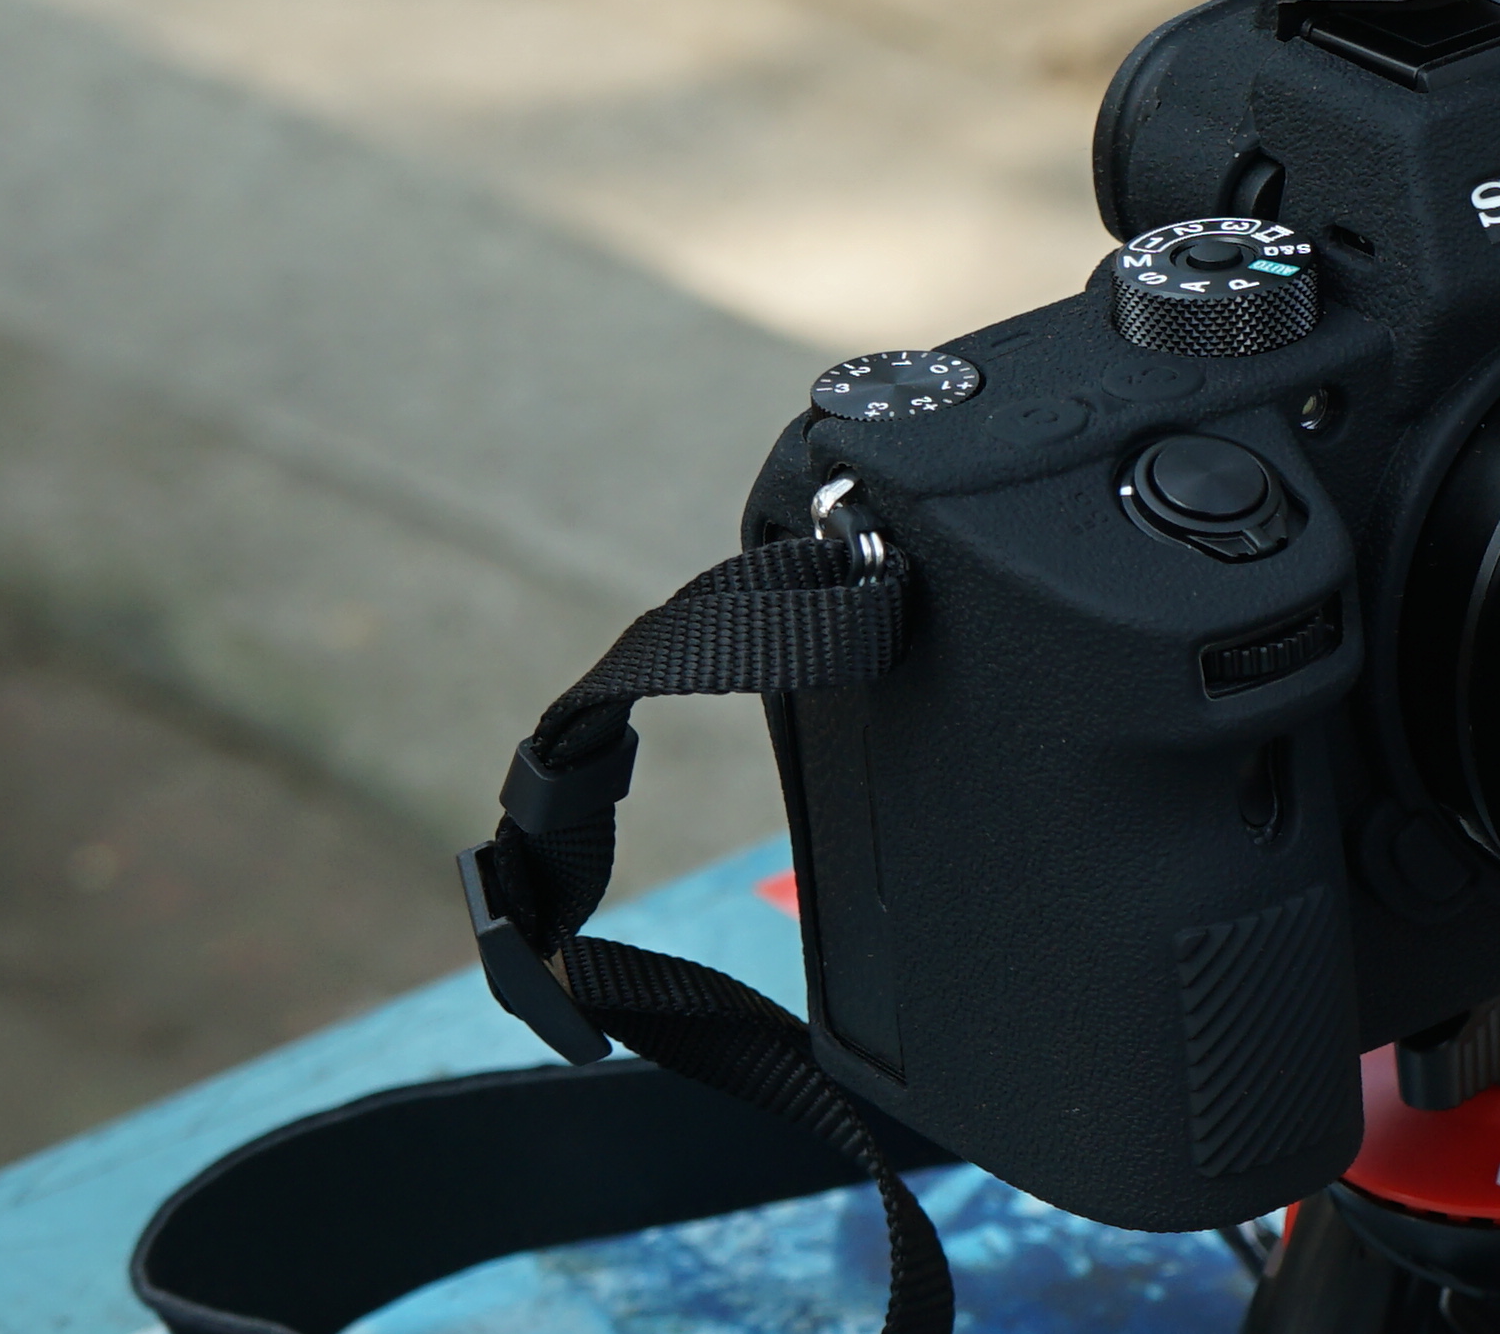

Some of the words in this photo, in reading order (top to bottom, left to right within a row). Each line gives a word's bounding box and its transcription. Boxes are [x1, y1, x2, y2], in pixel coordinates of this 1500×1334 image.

[1145, 236, 1164, 249] 1
[1173, 223, 1204, 236] 2
[1220, 220, 1250, 232] 3
[1263, 243, 1312, 257] S&Q
[1123, 253, 1153, 269] M
[1253, 260, 1299, 276] AUTO
[1137, 271, 1169, 286] S
[1228, 278, 1261, 292] P
[1179, 280, 1211, 294] A
[929, 364, 949, 375] 0
